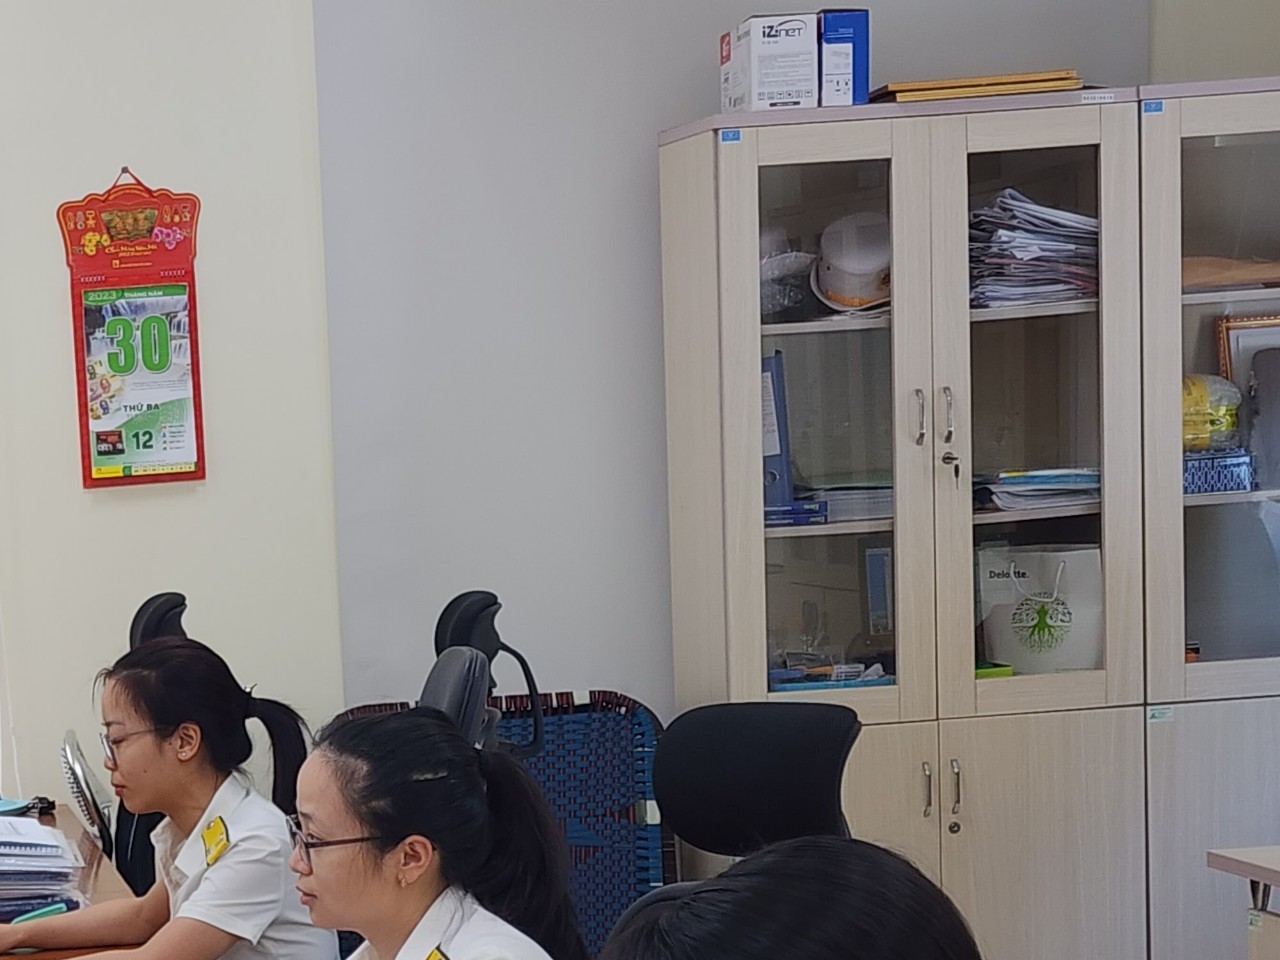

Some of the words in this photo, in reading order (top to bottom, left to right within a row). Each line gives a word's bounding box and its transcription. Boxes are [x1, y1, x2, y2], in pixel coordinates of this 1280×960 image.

[88, 290, 117, 301] 2023
[105, 314, 172, 376] 30
[122, 402, 144, 413] THỨ
[146, 403, 161, 411] BA
[131, 430, 154, 450] 12
